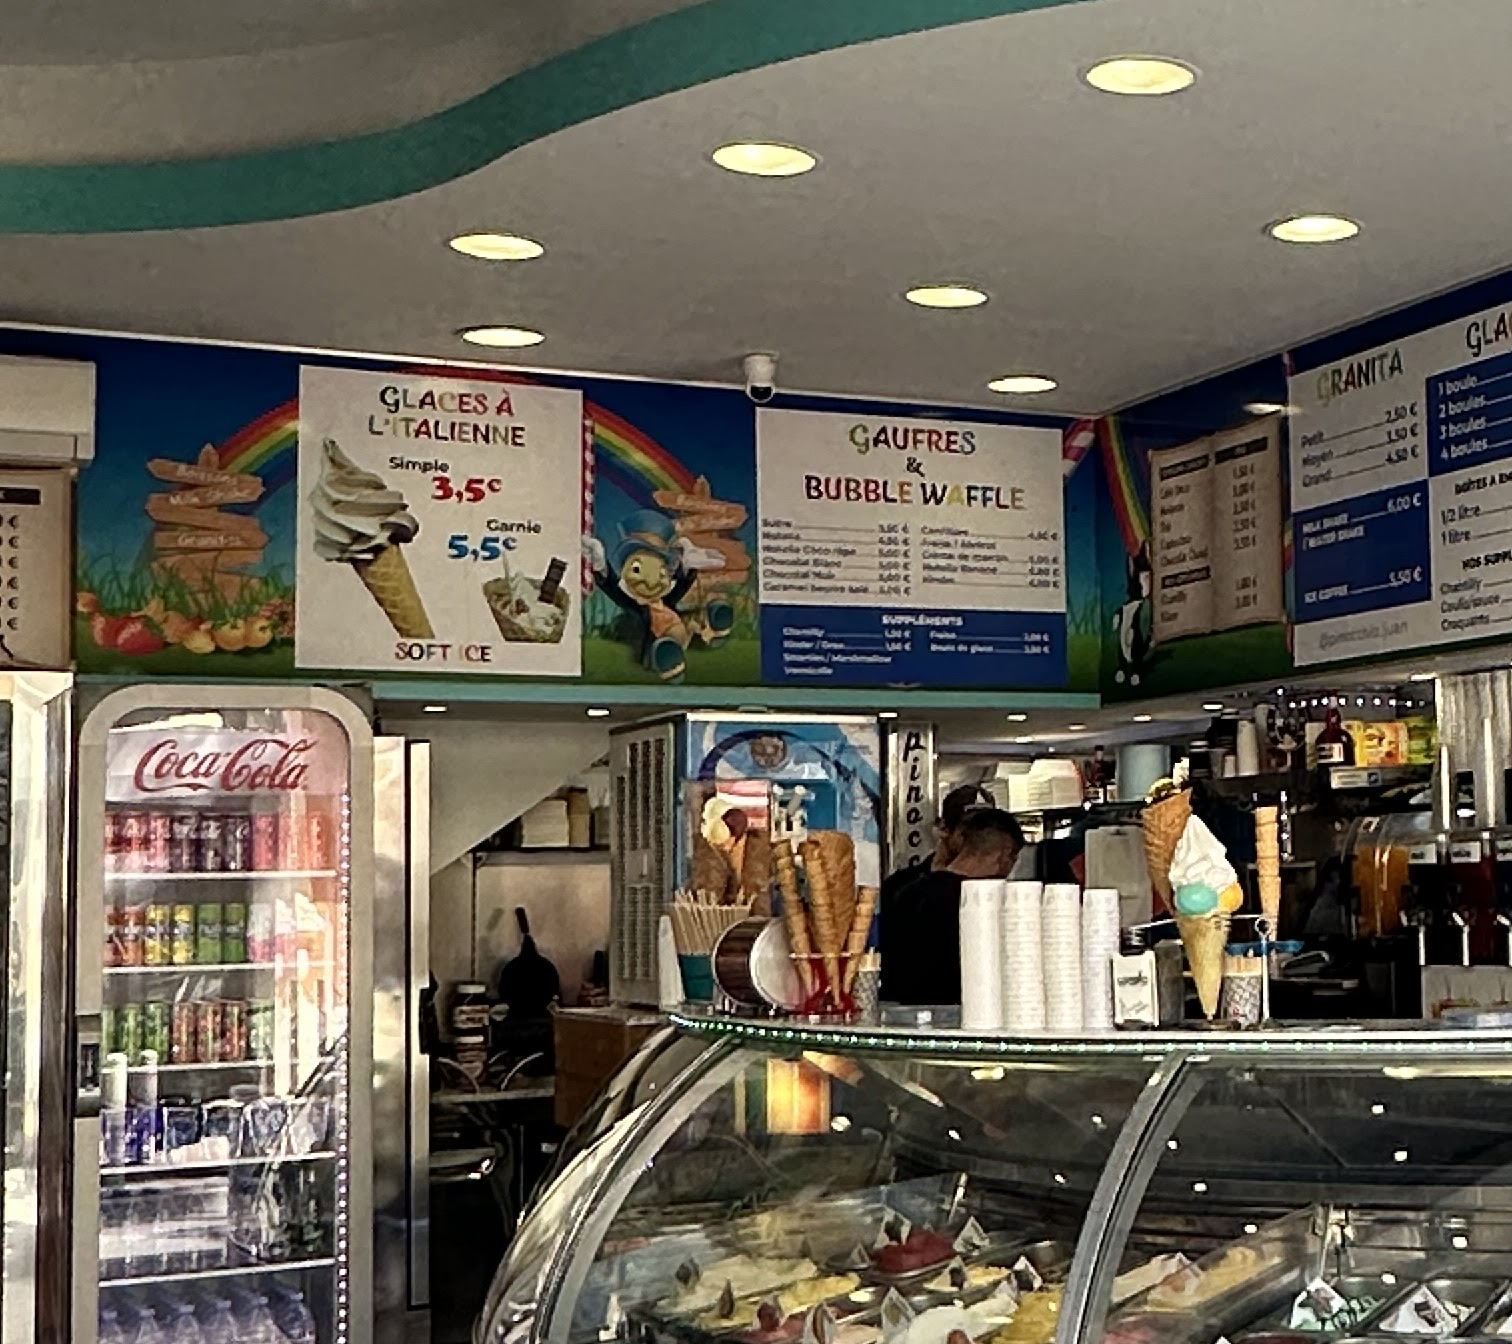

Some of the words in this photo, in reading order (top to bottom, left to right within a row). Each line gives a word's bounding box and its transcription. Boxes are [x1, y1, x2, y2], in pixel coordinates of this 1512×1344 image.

[1316, 349, 1403, 408] GRANITA
[379, 385, 489, 418] GLACES
[494, 388, 514, 417] À
[368, 415, 526, 448] L'ITALIENNE
[849, 423, 976, 456] GAUFRES
[388, 456, 451, 475] Simple
[906, 457, 926, 478] &
[804, 473, 913, 504] BUBBLE
[918, 481, 1026, 511] WAFFLE
[485, 518, 542, 534] Garnie
[394, 641, 453, 662] SOFT
[457, 643, 493, 663] ICE
[133, 738, 318, 793] Coca-Cola
